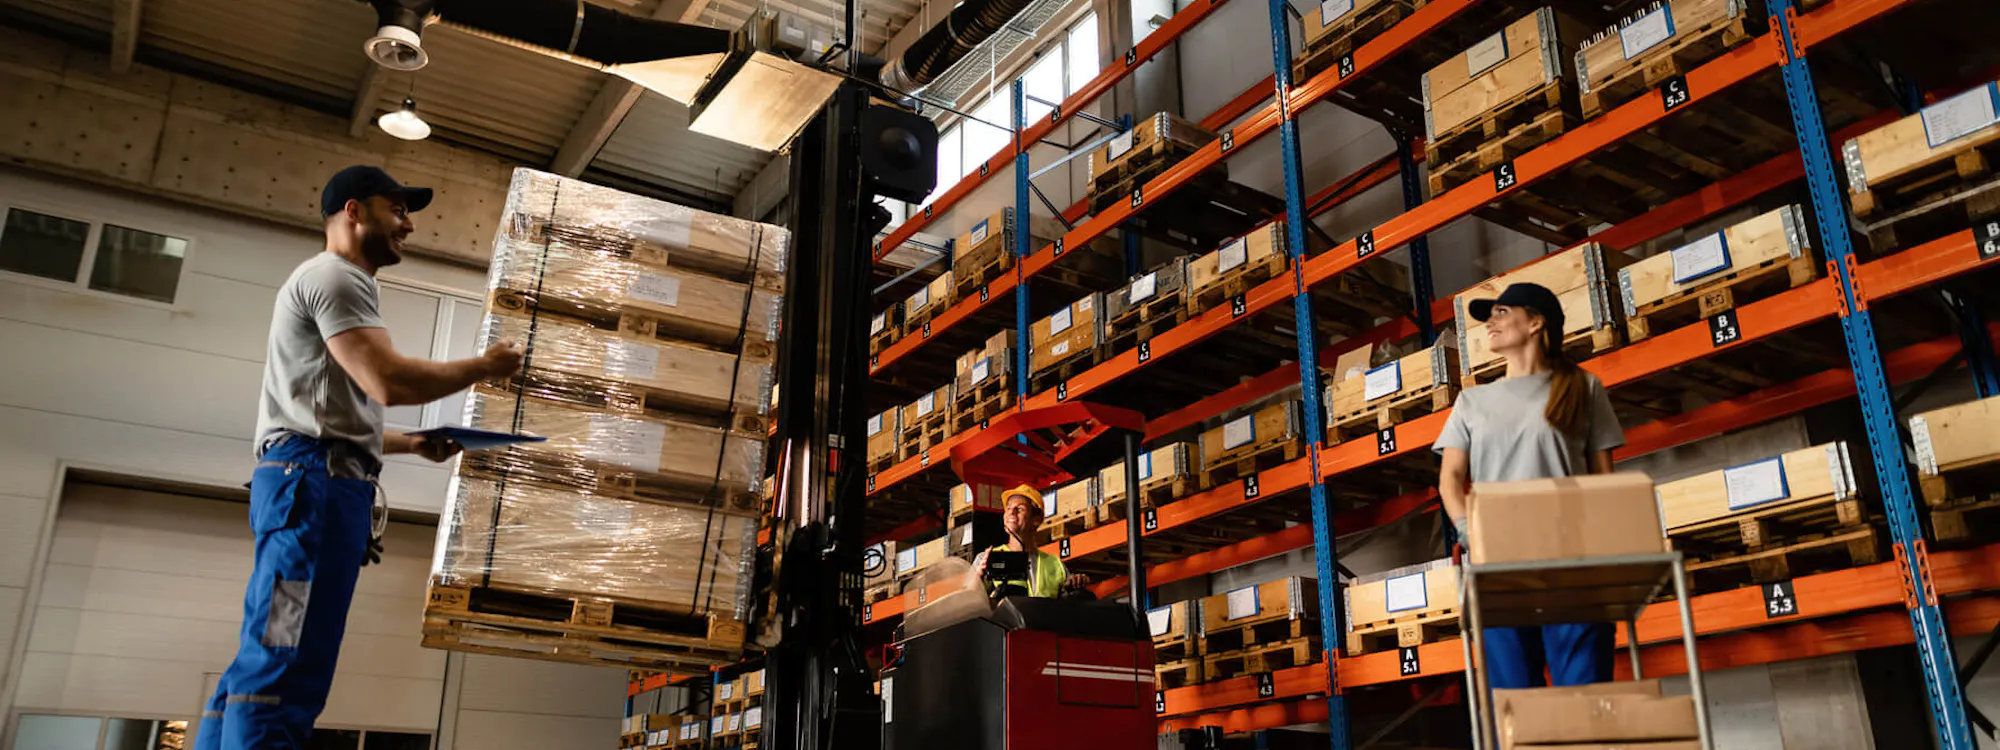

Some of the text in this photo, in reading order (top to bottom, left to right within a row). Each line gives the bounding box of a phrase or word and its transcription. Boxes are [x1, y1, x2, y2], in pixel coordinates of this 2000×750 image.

[1343, 57, 1350, 66] D
[1341, 64, 1353, 78] 5.1
[1670, 81, 1678, 92] C
[1667, 91, 1685, 107] 5.3
[1223, 133, 1229, 141] D
[1501, 165, 1507, 175] C
[1498, 174, 1513, 189] 5.2
[1134, 190, 1139, 198] D
[1987, 222, 2000, 238] B
[1362, 233, 1369, 243] C
[1360, 242, 1372, 255] 5.1
[1236, 296, 1241, 305] C
[1234, 304, 1245, 315] 4.3
[1718, 315, 1728, 328] B
[1716, 326, 1736, 343] 5.3
[1141, 343, 1146, 351] C
[1060, 383, 1065, 391] C
[1383, 430, 1390, 440] B
[1381, 440, 1394, 453] 5.1
[1248, 477, 1254, 486] B
[1148, 511, 1153, 520] B
[1774, 584, 1784, 598] A
[1770, 598, 1792, 614] 5.3
[1406, 649, 1413, 660] A
[1403, 660, 1418, 673] 5.1
[1263, 675, 1269, 685] A
[1156, 692, 1162, 702] A
